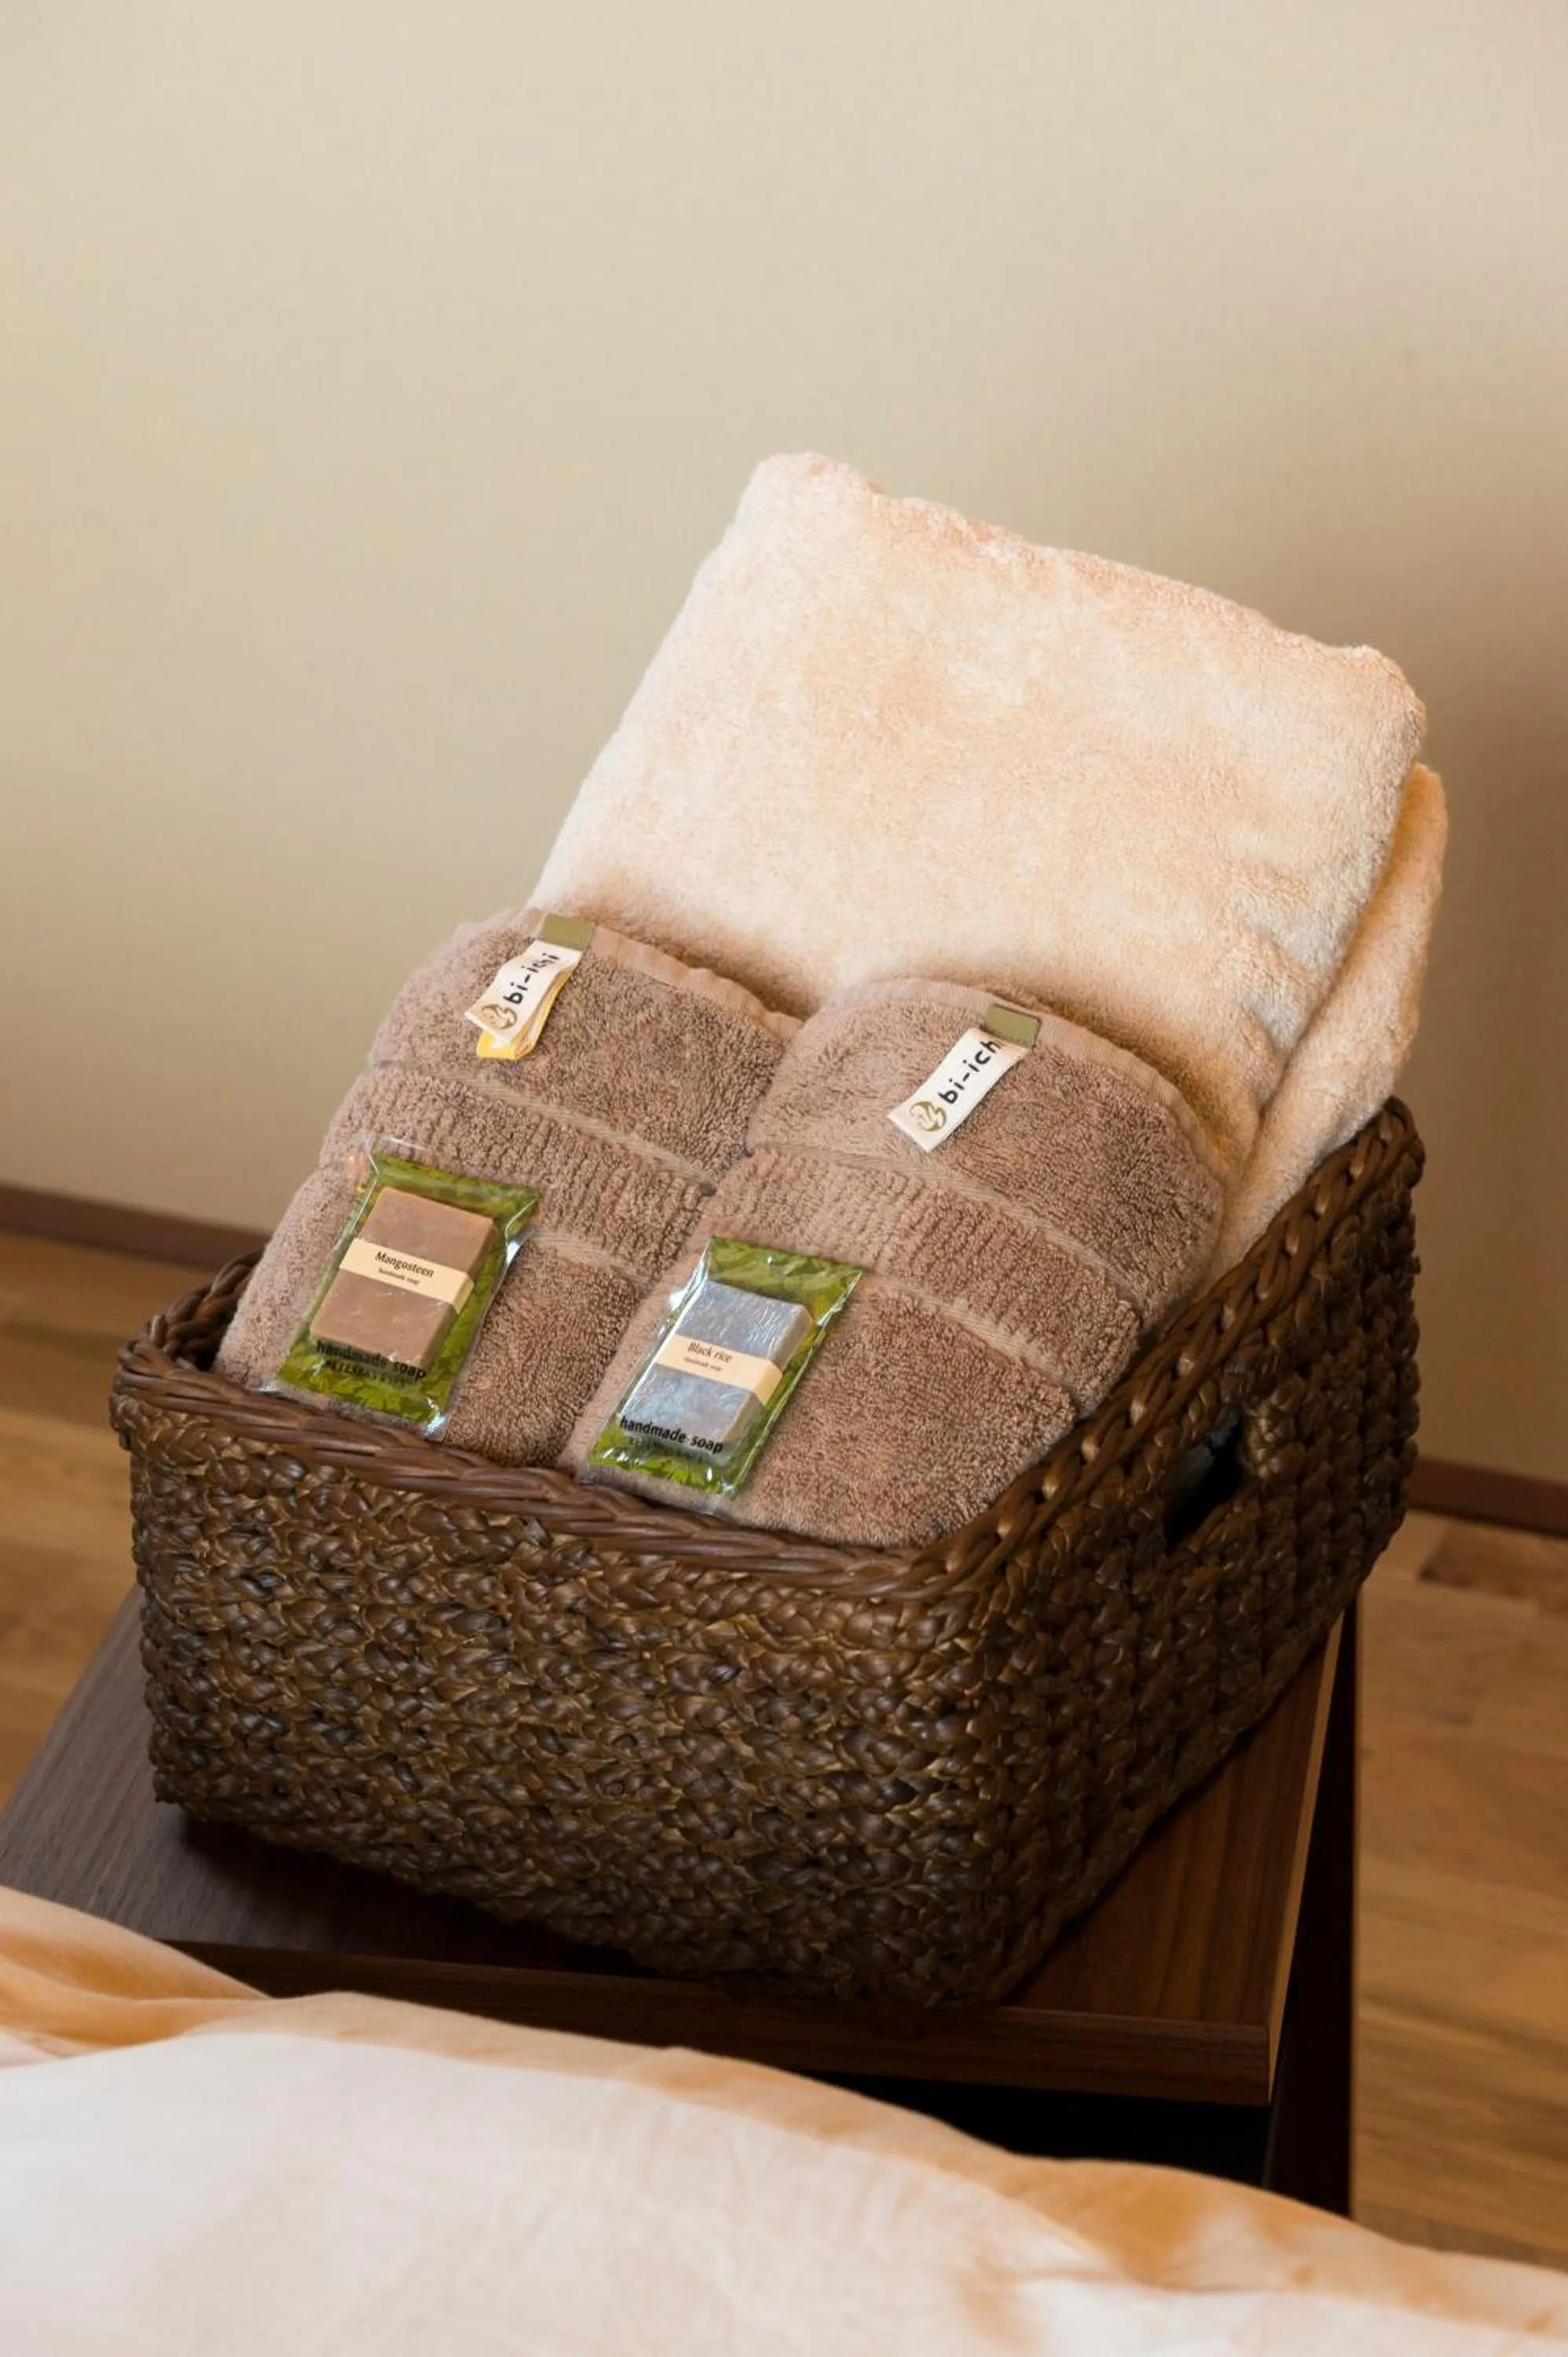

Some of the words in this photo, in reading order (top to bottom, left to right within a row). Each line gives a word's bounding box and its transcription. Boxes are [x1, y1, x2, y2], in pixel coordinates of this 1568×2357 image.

[375, 1252, 434, 1278] Mangosteen
[687, 1342, 712, 1358] Black
[713, 1351, 733, 1363] rice
[392, 1361, 427, 1382] soap
[620, 1415, 687, 1443] handmade
[691, 1435, 724, 1454] soap
